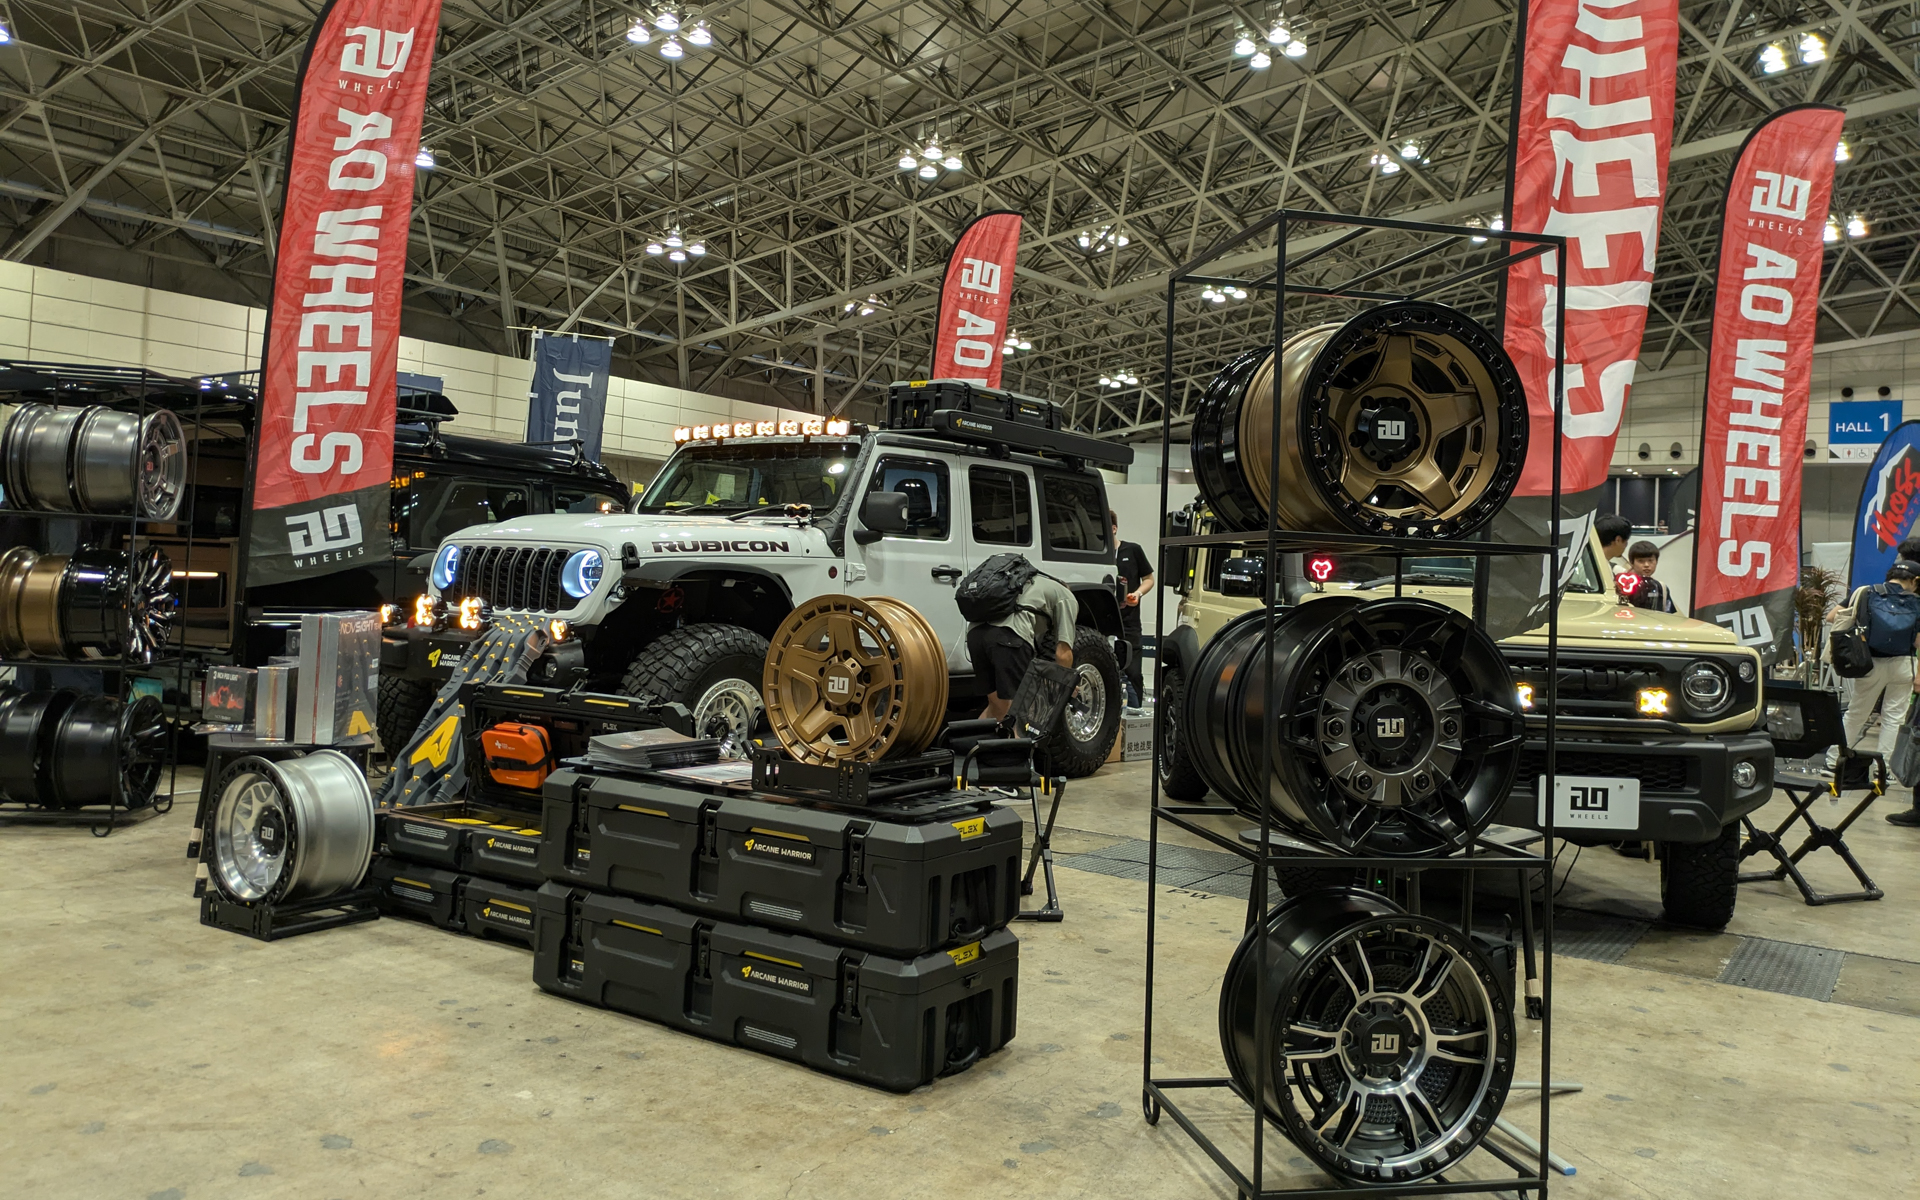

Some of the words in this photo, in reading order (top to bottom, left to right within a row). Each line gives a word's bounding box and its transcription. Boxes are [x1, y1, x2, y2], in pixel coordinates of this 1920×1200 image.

[329, 107, 396, 191] AO
[1748, 218, 1803, 236] WHEELS
[1740, 242, 1797, 325] AO
[959, 292, 999, 305] WHEELS
[290, 205, 385, 475] WHEELS
[1835, 422, 1872, 433] HALL
[1879, 412, 1890, 432] 1
[1717, 338, 1788, 580] WHEELS
[294, 546, 364, 568] WHEELS
[652, 540, 790, 553] RUBICON
[493, 841, 512, 850] ARCANE
[512, 843, 535, 854] WARRIOR
[753, 843, 780, 854] ARCANE
[781, 848, 812, 860] WARRIOR
[489, 910, 508, 921] ARCANE
[508, 913, 531, 926] WARRIOR
[750, 970, 777, 983] ARCANE
[777, 976, 809, 991] WARRIOR
